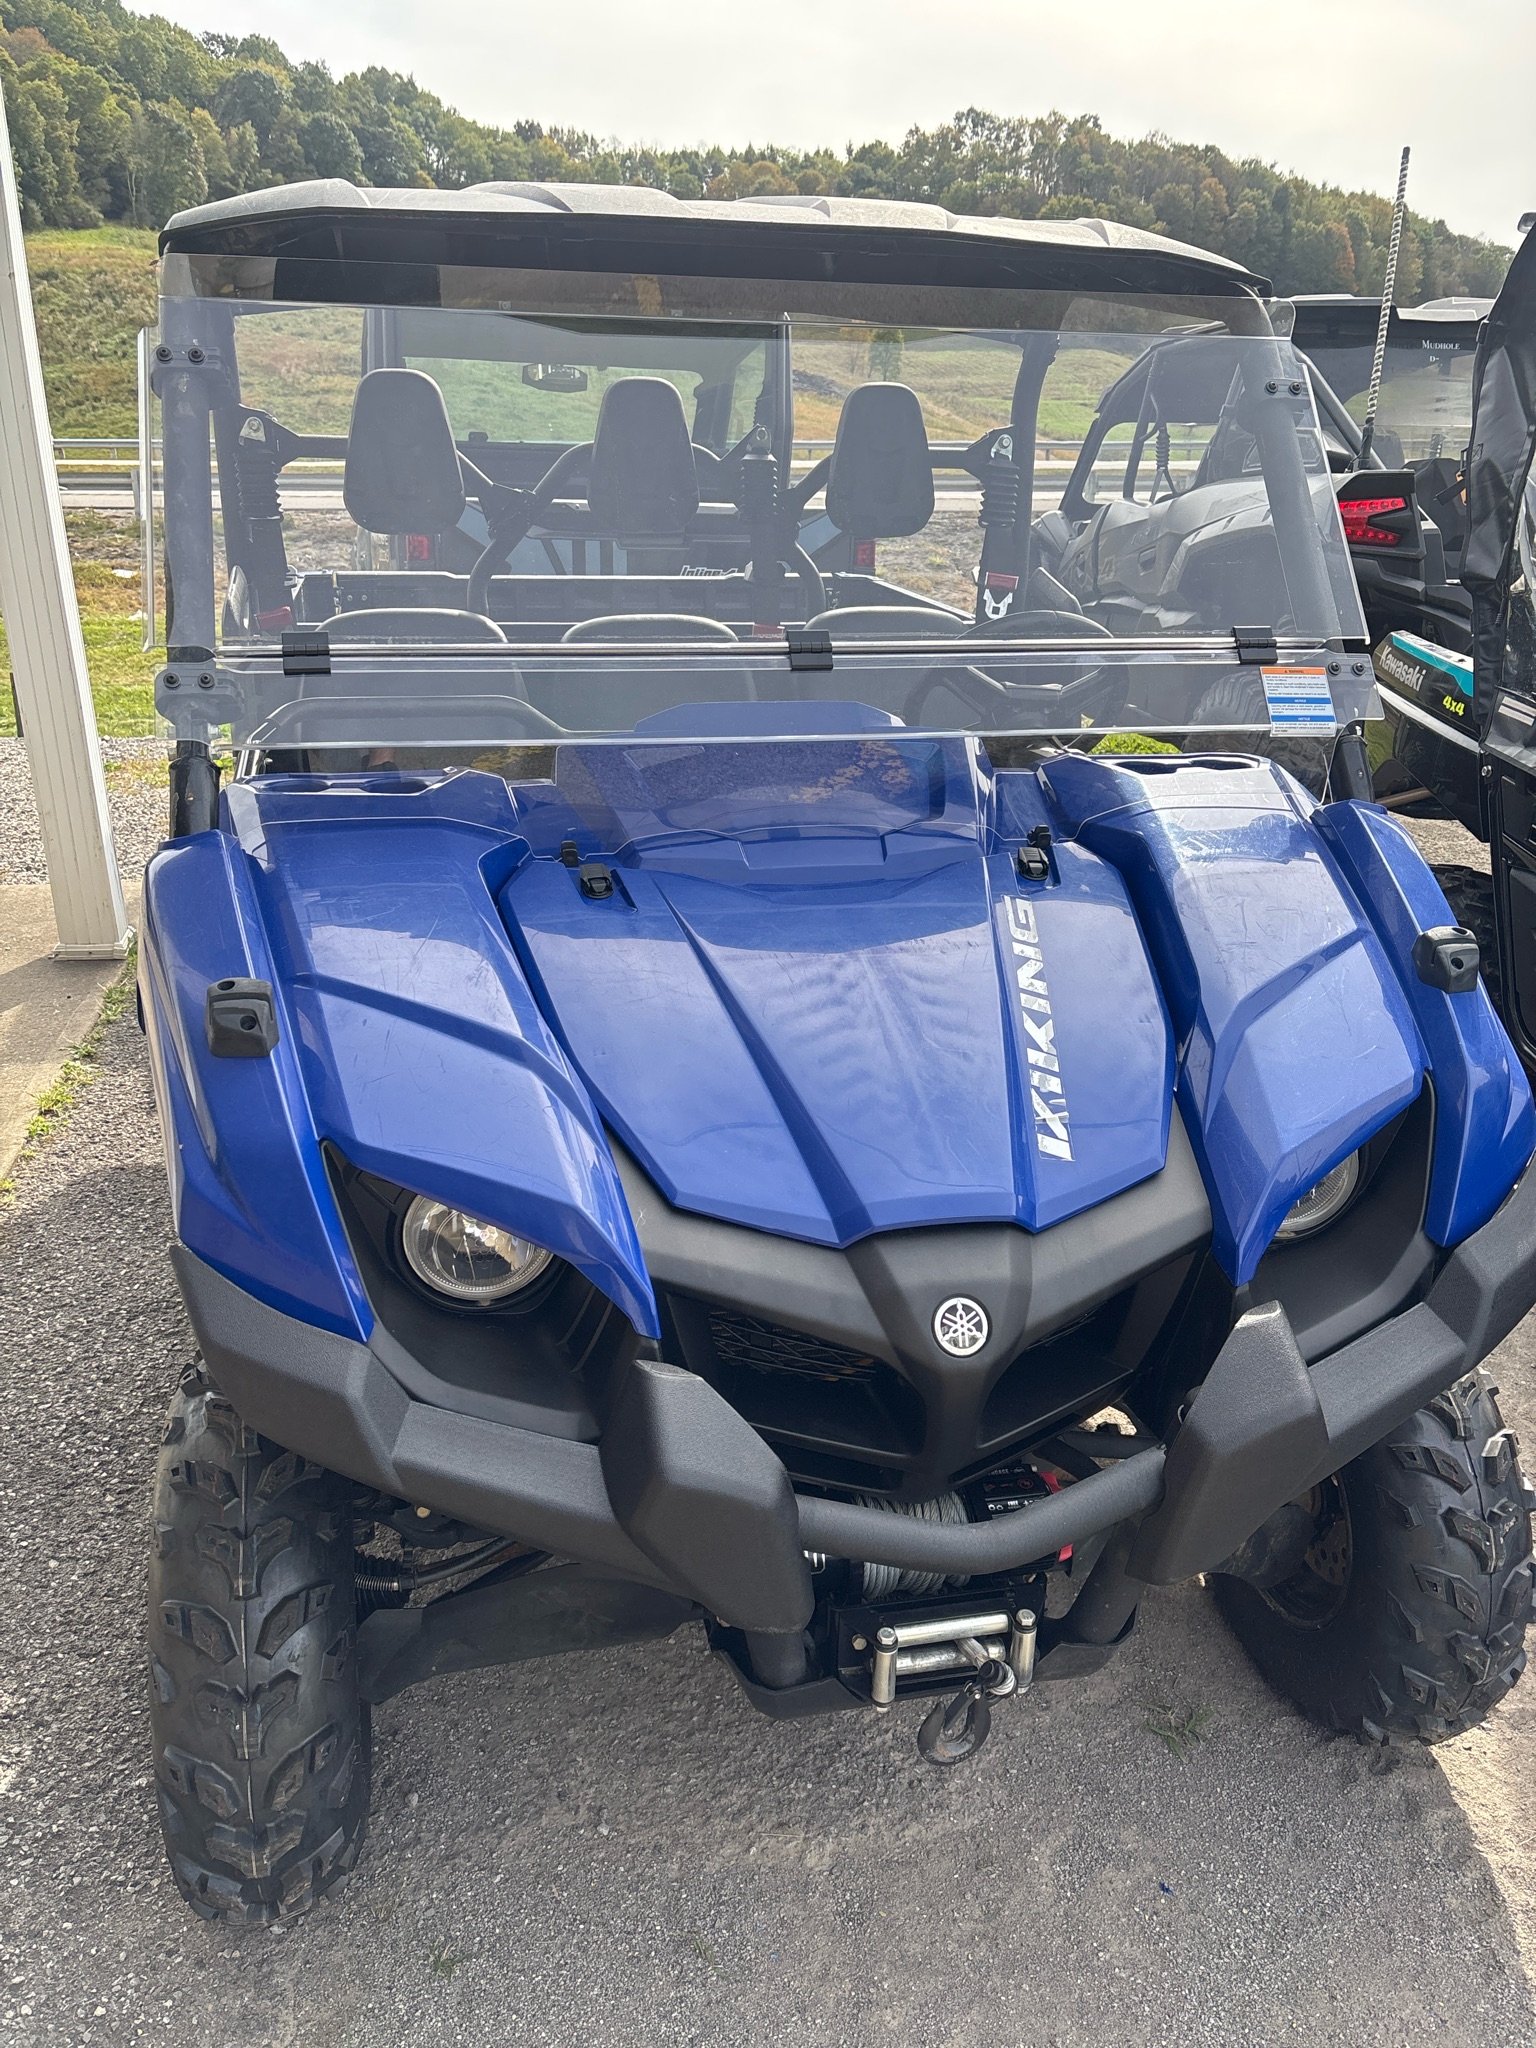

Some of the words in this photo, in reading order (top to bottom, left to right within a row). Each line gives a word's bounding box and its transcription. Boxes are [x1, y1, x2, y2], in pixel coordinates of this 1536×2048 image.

[1422, 339, 1461, 350] MUDHOLE
[1379, 644, 1427, 692] Kawasaki
[1442, 695, 1466, 717] 4x4
[1003, 894, 1073, 1161] VIKING
